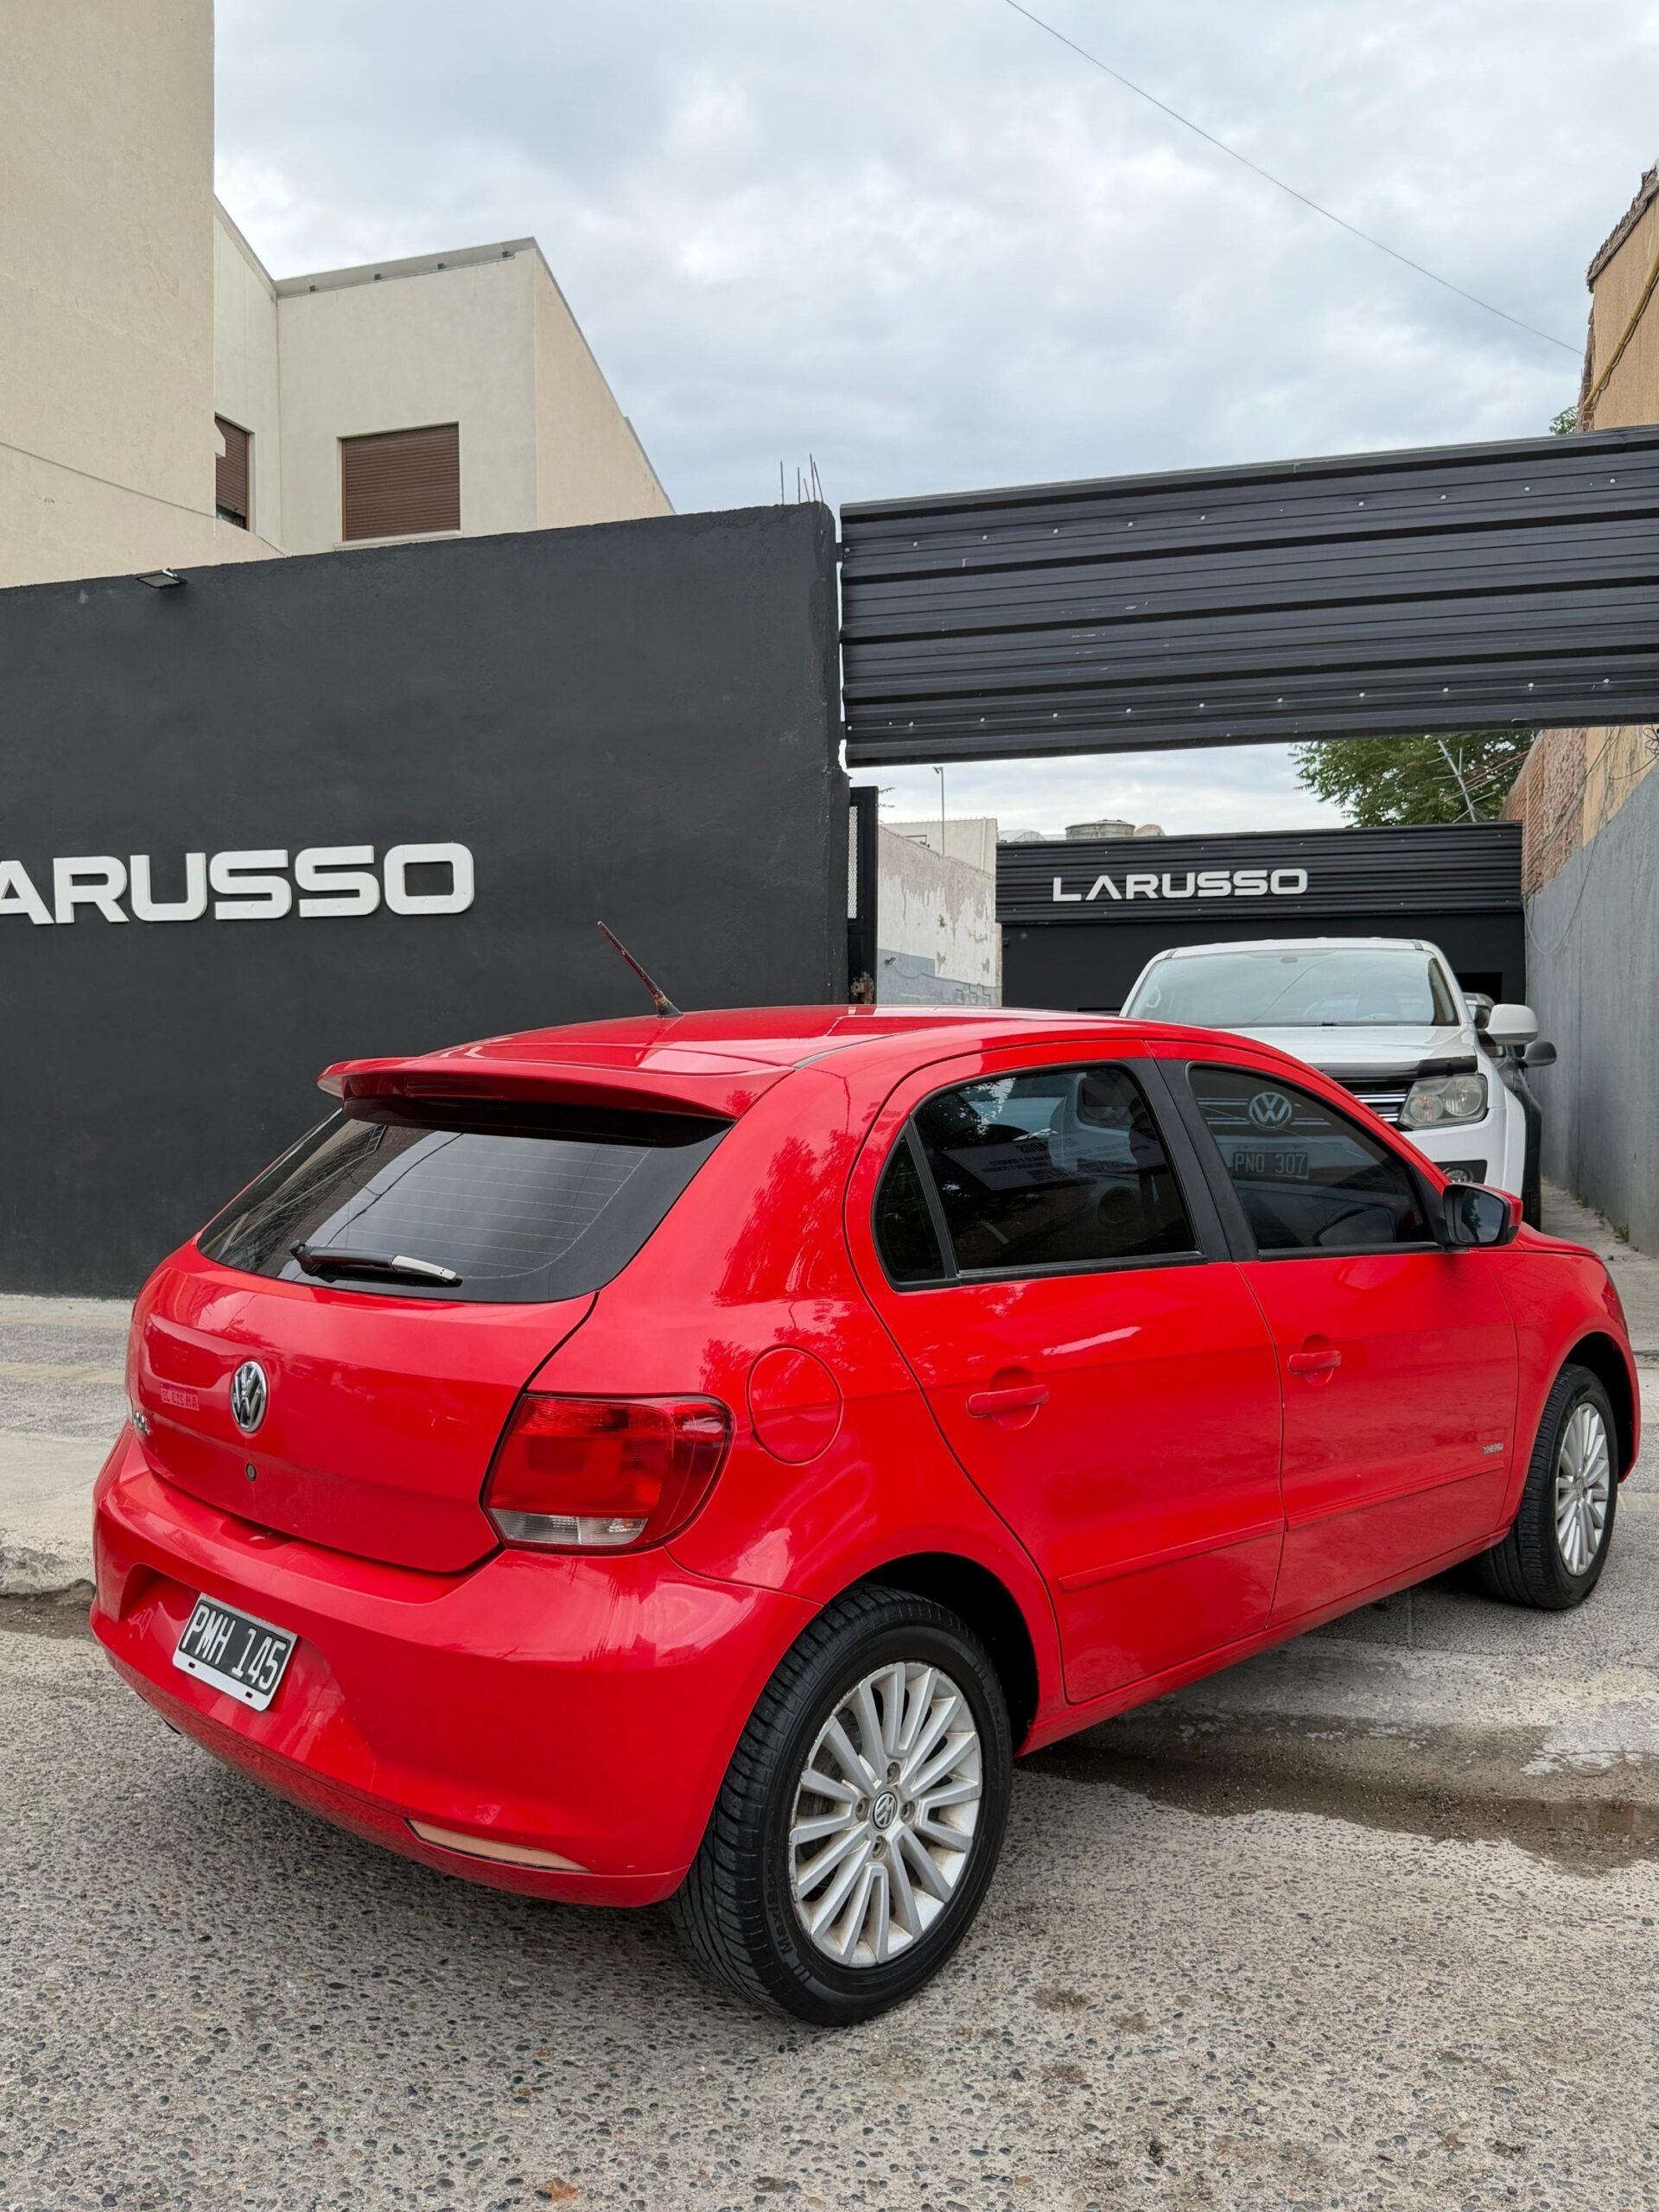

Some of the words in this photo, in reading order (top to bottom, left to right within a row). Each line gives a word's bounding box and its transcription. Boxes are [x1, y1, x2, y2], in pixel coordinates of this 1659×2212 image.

[1052, 868, 1308, 902] LARUSSO
[1235, 1153, 1265, 1173] PNO
[1274, 1153, 1306, 1174] 307
[181, 1604, 236, 1664] PMH
[232, 1628, 287, 1689] 145
